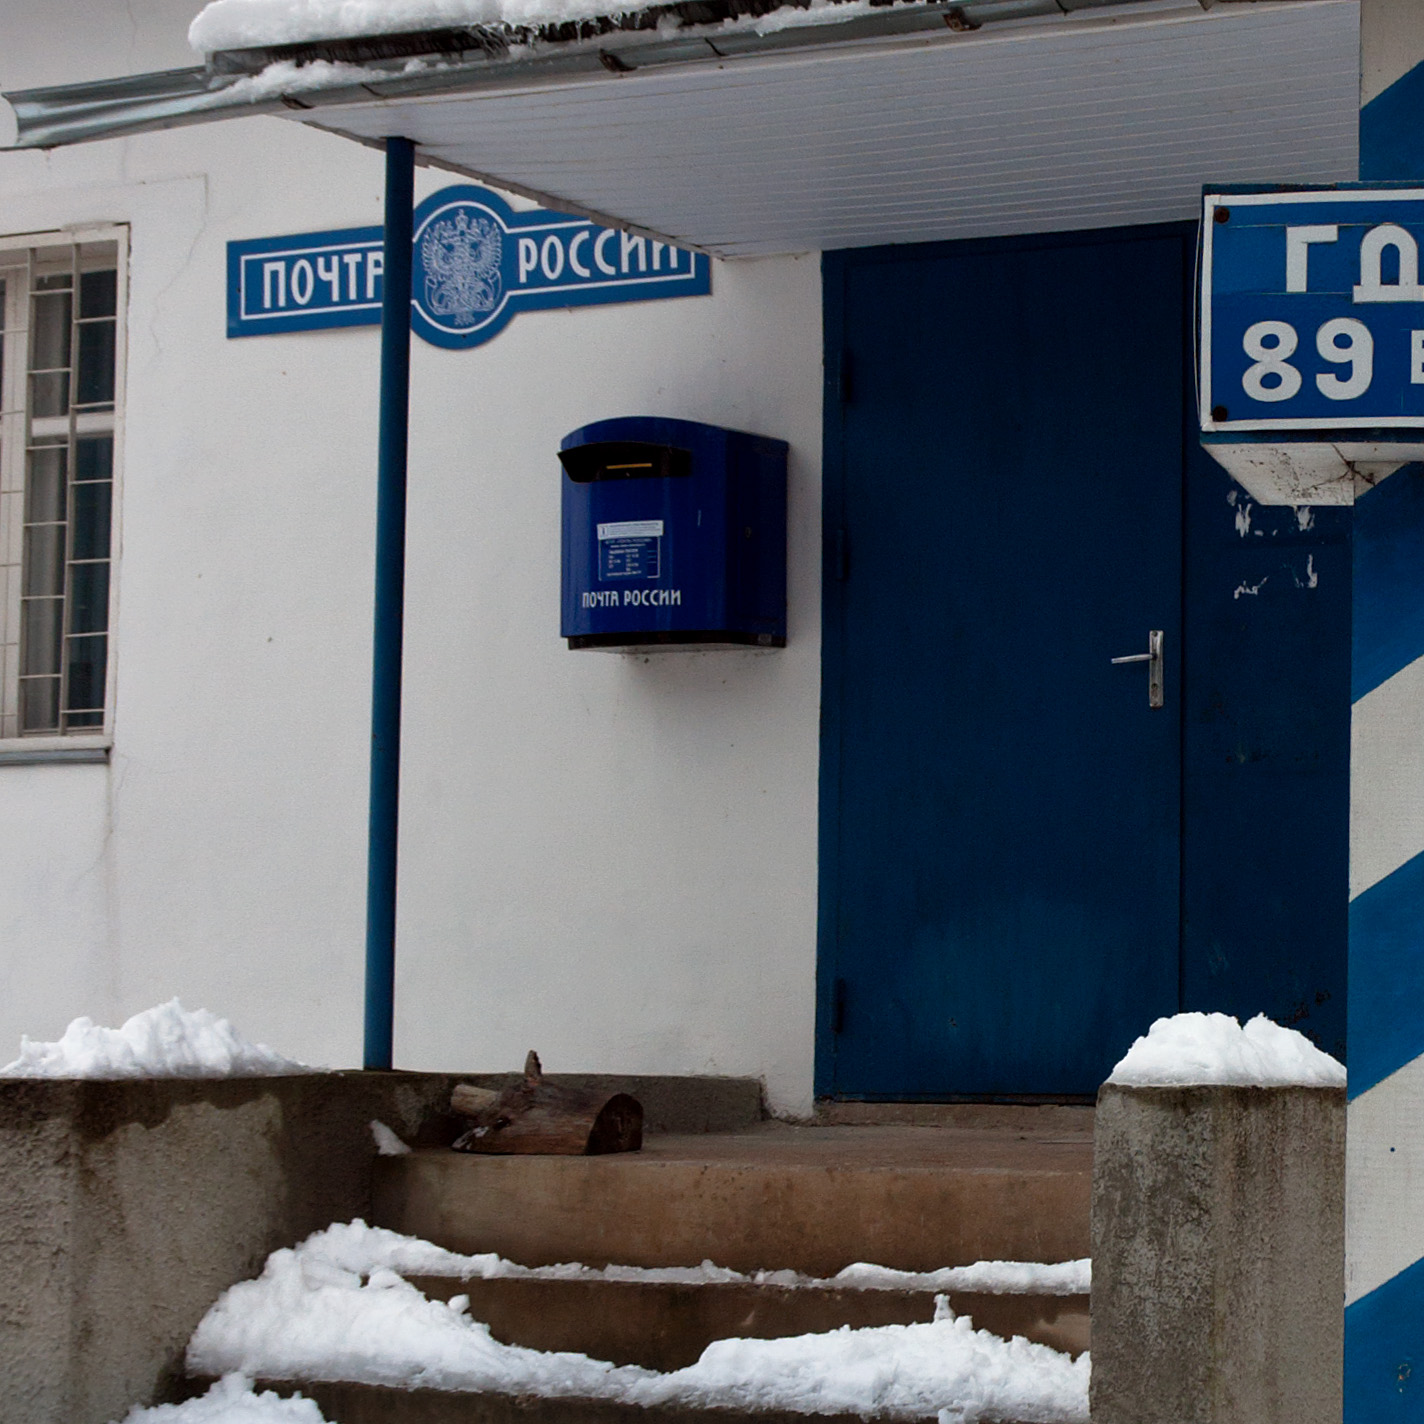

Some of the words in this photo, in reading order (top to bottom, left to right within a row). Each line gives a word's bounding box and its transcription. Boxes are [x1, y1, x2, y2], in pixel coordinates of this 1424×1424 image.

[1241, 317, 1375, 403] 89
[582, 591, 619, 608] ПОЧТА
[624, 589, 681, 606] РОССИИ
